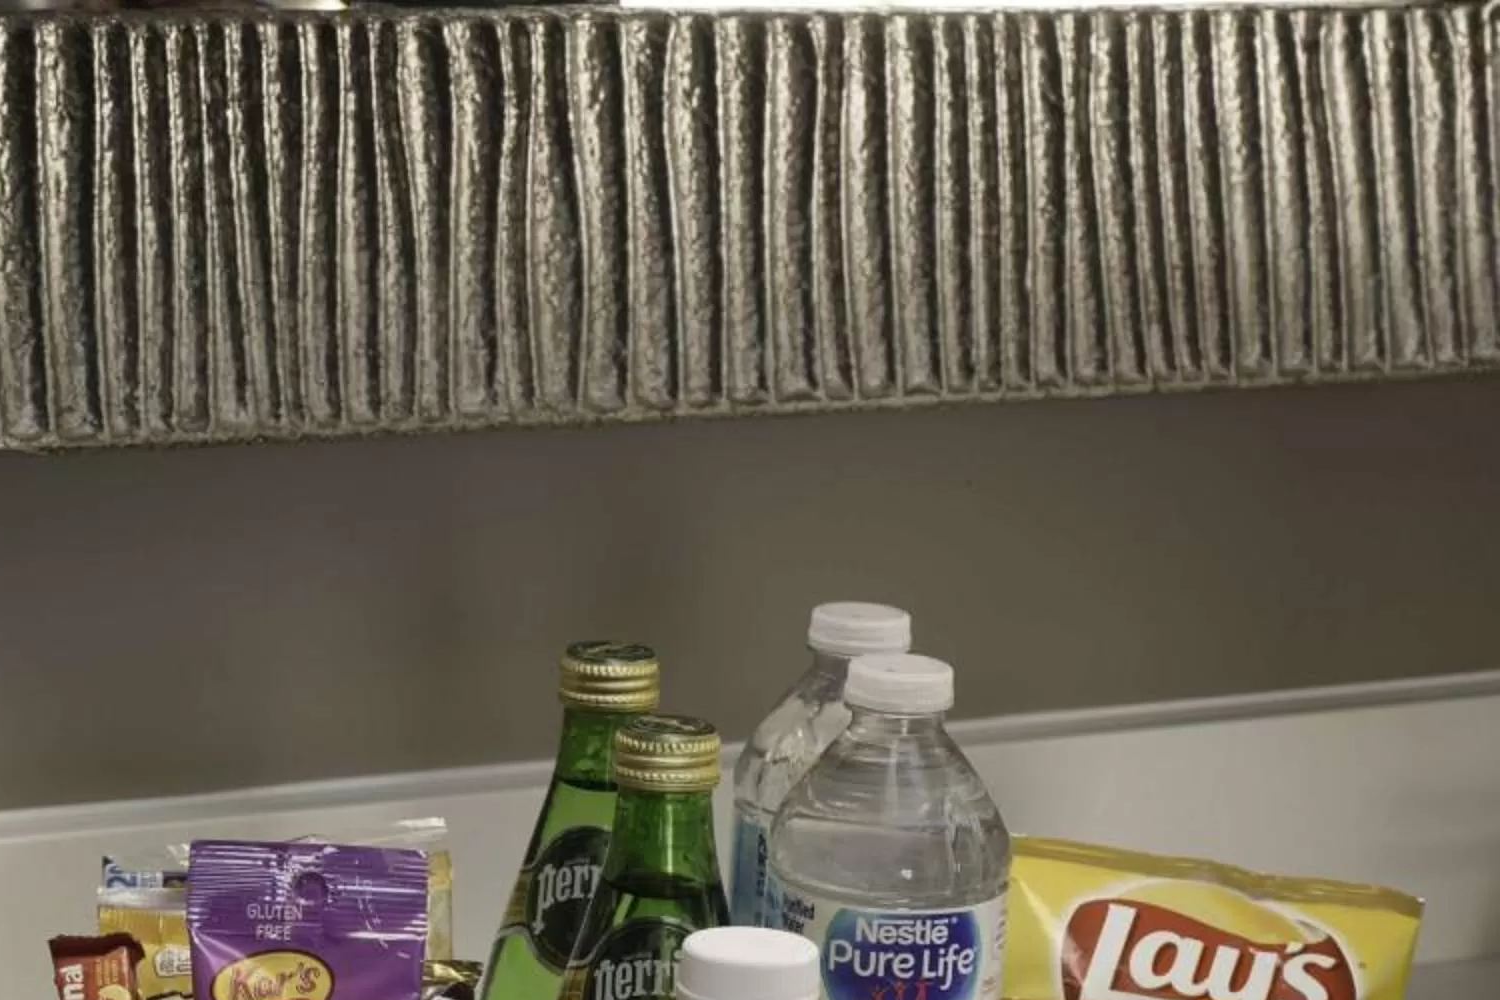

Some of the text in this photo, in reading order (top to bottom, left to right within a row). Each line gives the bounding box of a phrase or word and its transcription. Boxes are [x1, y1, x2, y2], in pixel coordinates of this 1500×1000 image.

[246, 903, 304, 921] GLUTEN
[255, 923, 293, 941] FREE
[829, 939, 975, 990] Pure Life
